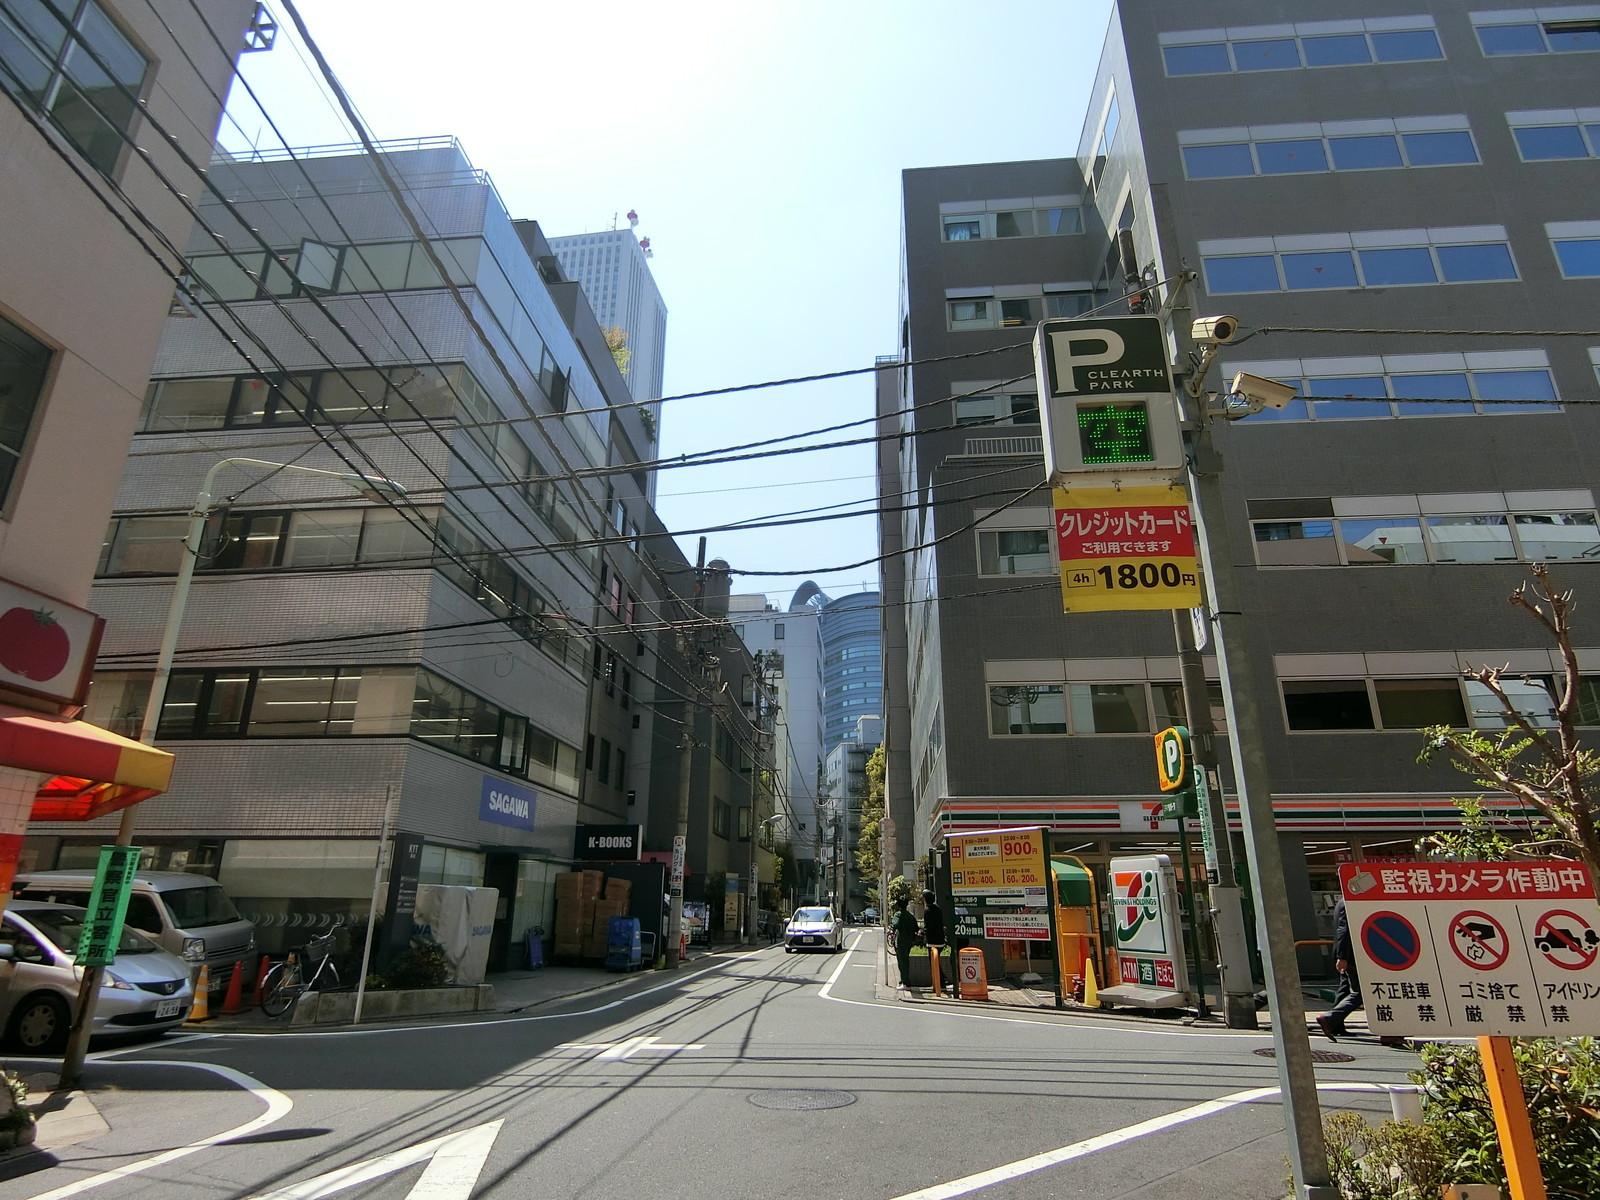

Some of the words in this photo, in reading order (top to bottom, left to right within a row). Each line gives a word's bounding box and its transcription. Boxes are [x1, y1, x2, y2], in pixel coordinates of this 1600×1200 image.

[1048, 328, 1125, 394] P
[1088, 368, 1164, 380] CLEARTH
[1089, 379, 1135, 391] PARK
[1078, 405, 1151, 464] 空
[1059, 509, 1189, 538] クレジットカード
[1081, 540, 1172, 554] ご利用できます
[1073, 573, 1090, 584] 4h
[1097, 562, 1196, 589] 1800円
[1164, 739, 1178, 778] P
[488, 790, 529, 819] SAGAWA
[588, 836, 632, 848] K-BOOKS
[1380, 866, 1586, 894] 監視カメラ作動中
[1132, 898, 1157, 906] HOLDINGS
[1122, 963, 1138, 979] ATM
[1141, 962, 1153, 981] 酒
[1155, 964, 1174, 983] たばこ
[1370, 982, 1432, 1000] 不正駐車
[1458, 981, 1521, 1000] ゴミ捨て
[1550, 1004, 1570, 1022] 禁
